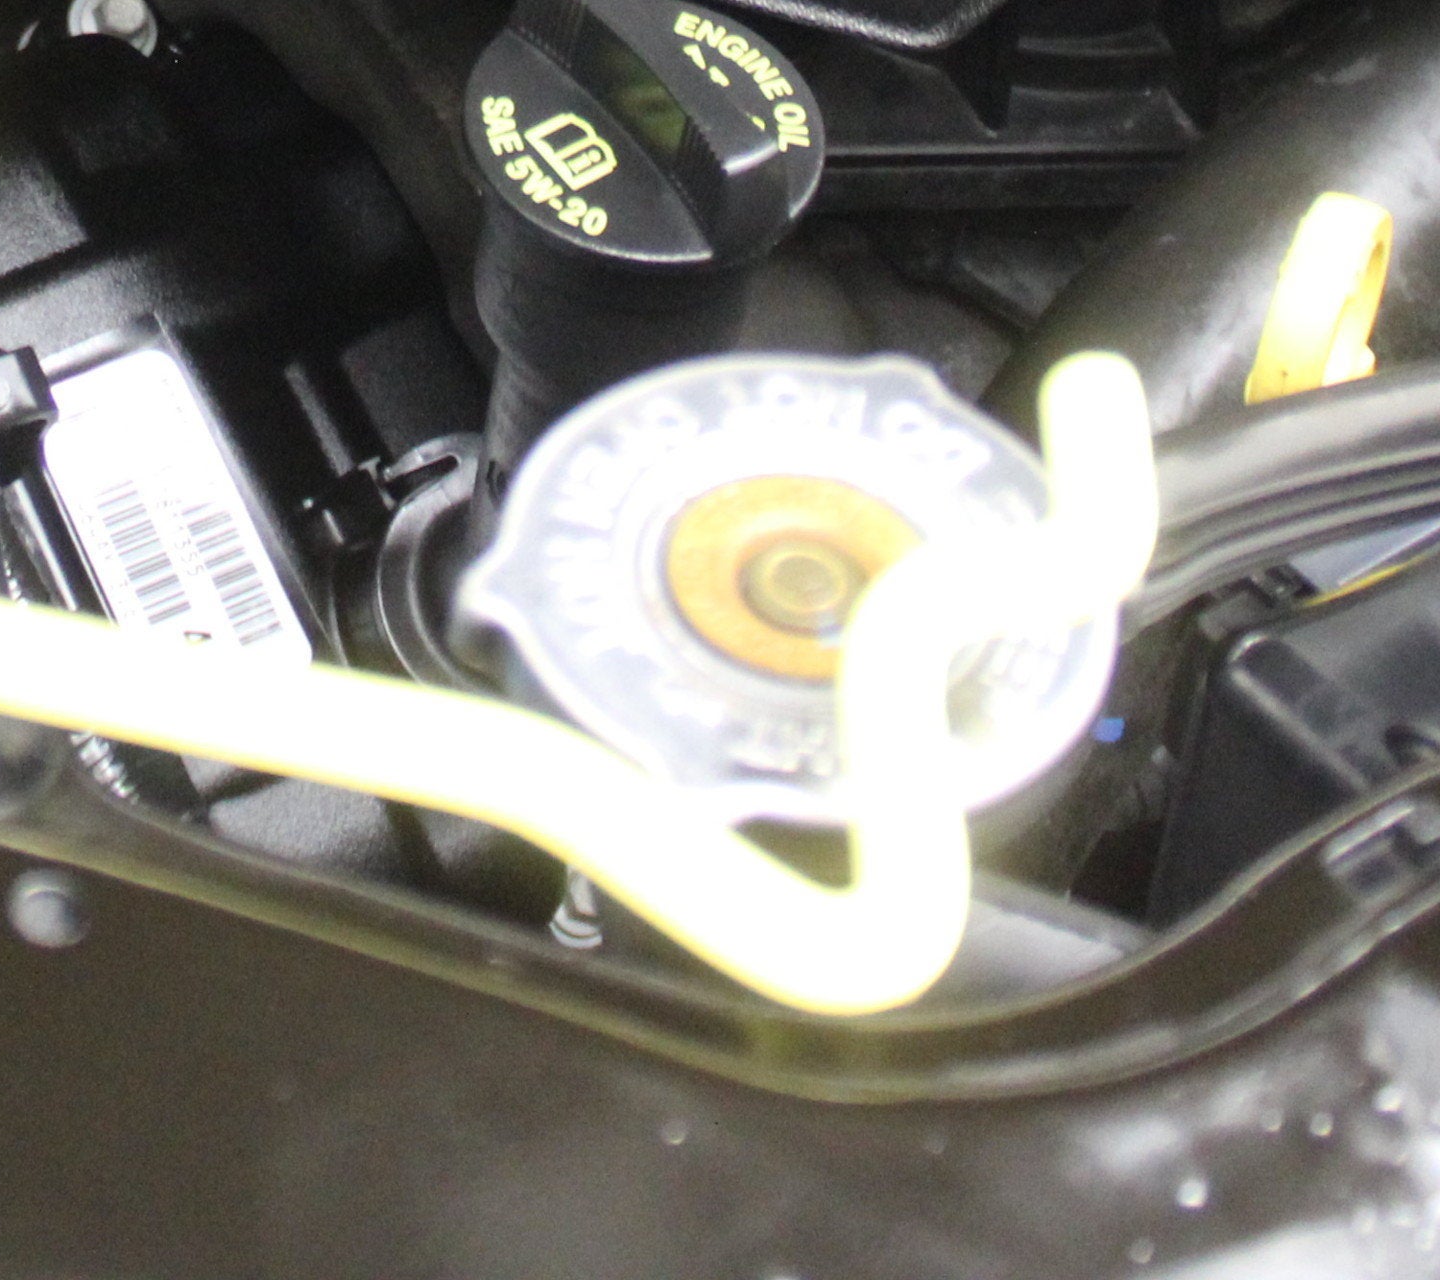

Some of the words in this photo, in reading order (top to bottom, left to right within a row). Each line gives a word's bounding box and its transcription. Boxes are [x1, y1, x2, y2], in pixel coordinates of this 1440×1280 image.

[674, 11, 794, 101] ENGINE
[773, 101, 811, 153] OIL
[481, 95, 523, 157] SAE
[504, 155, 609, 237] 5W-20
